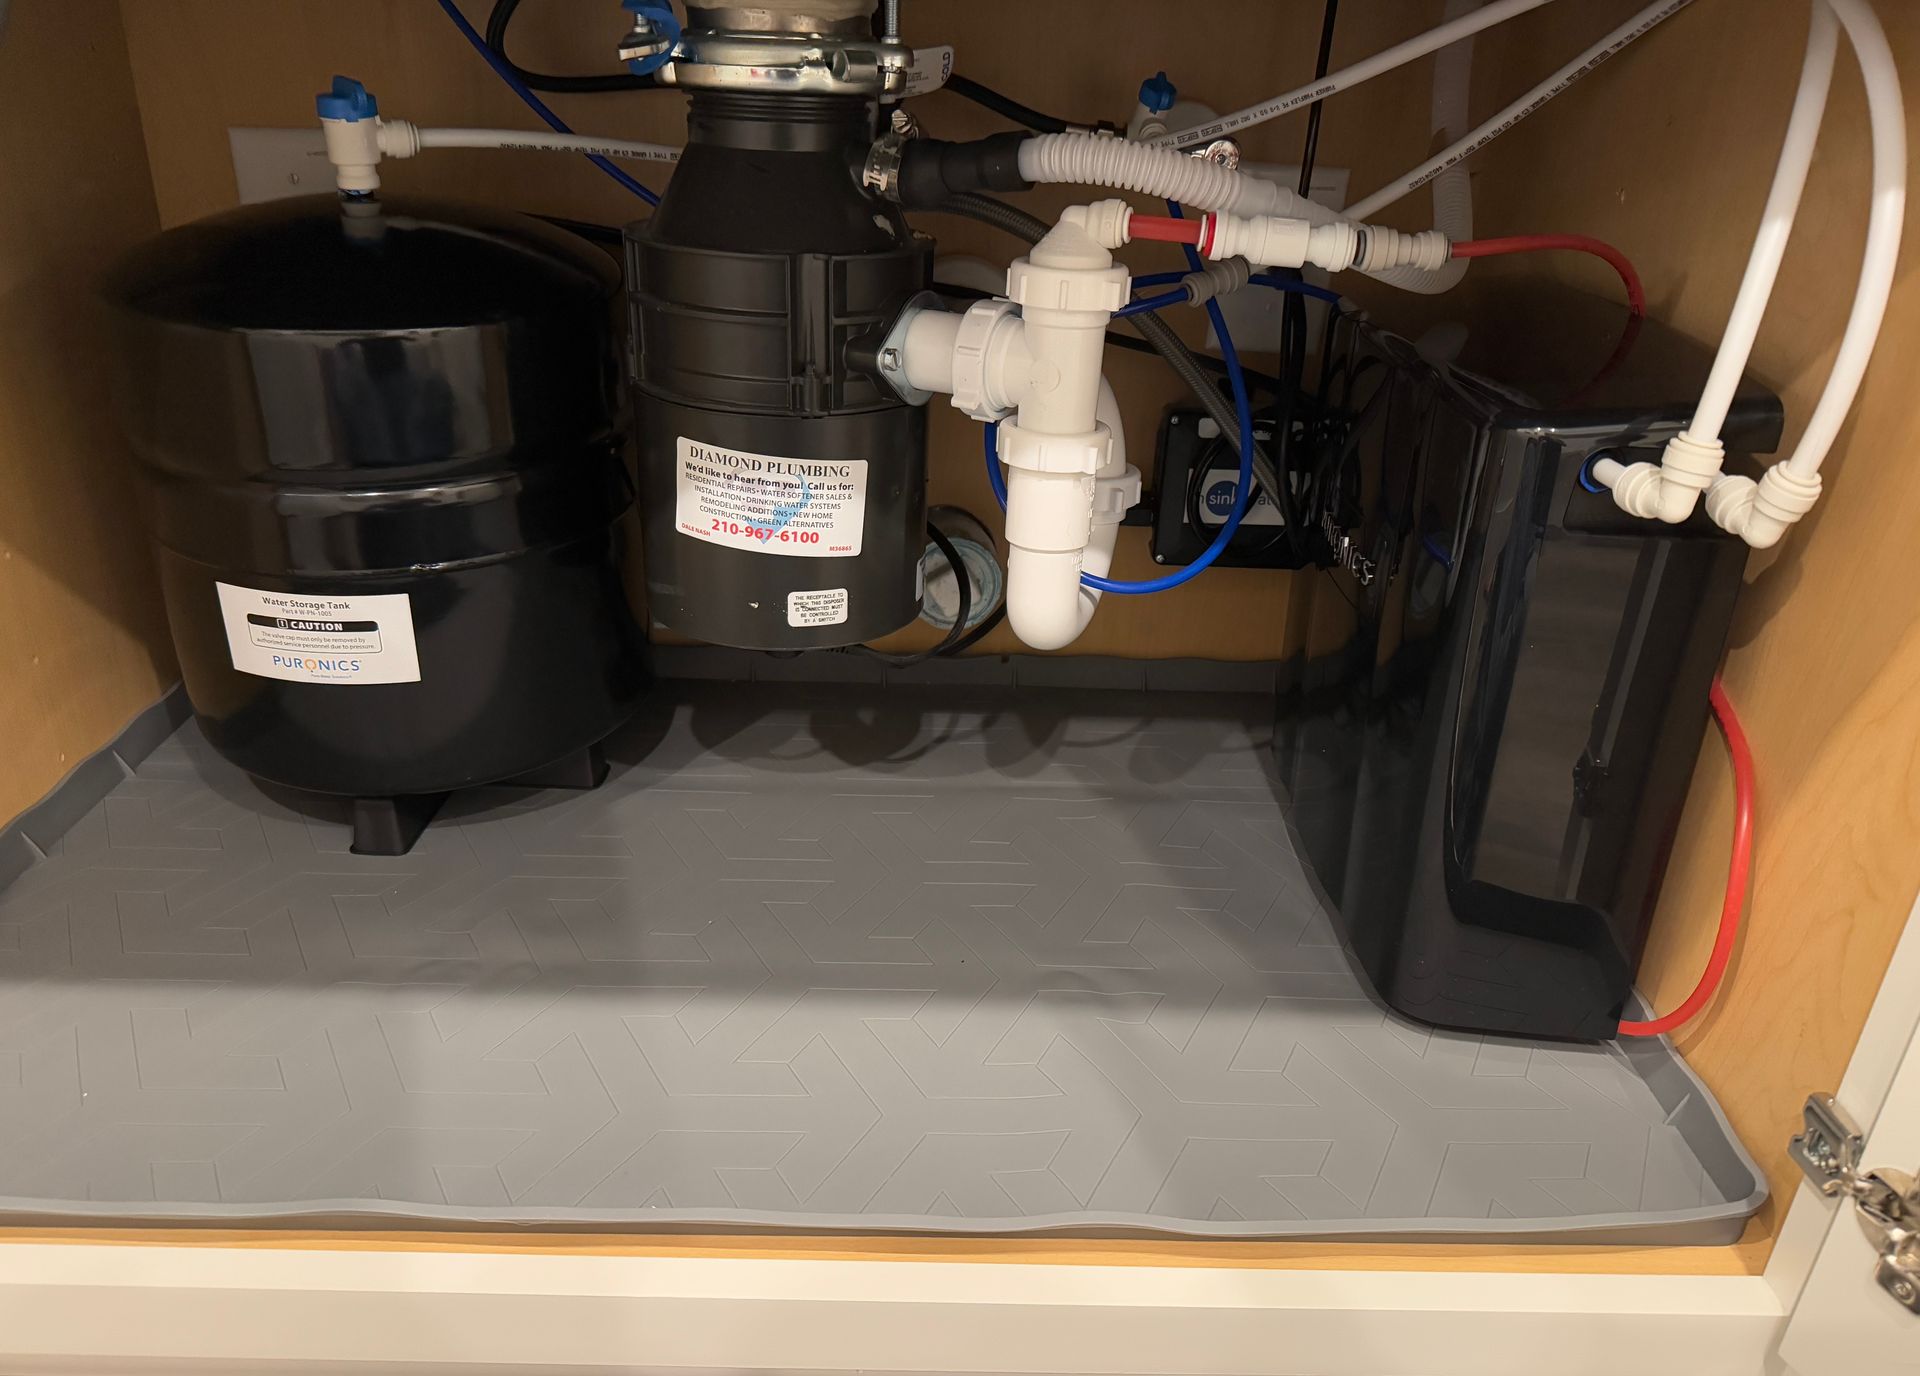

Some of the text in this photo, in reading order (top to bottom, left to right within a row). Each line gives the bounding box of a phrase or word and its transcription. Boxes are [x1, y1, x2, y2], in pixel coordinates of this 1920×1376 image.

[690, 445, 850, 478] DIAMOND PLUMBING
[685, 472, 726, 489] RESIDENTIAL
[760, 489, 785, 498] WATER
[787, 492, 824, 500] SOFTENER
[705, 467, 721, 478] like
[722, 472, 732, 480] to
[734, 473, 755, 485] hear
[757, 477, 780, 488] from
[783, 481, 804, 490] you!
[807, 482, 825, 491] Call
[839, 482, 854, 491] for:
[701, 496, 746, 512] REMODELING
[784, 501, 808, 509] WATER
[810, 502, 841, 510] SYSTEMS
[711, 518, 820, 543] 210-967-6100
[783, 520, 834, 528] ALTERNATIVES
[262, 597, 351, 610] Water Storage Tank
[290, 621, 343, 631] CAUTION
[273, 655, 360, 671] PURONICS
